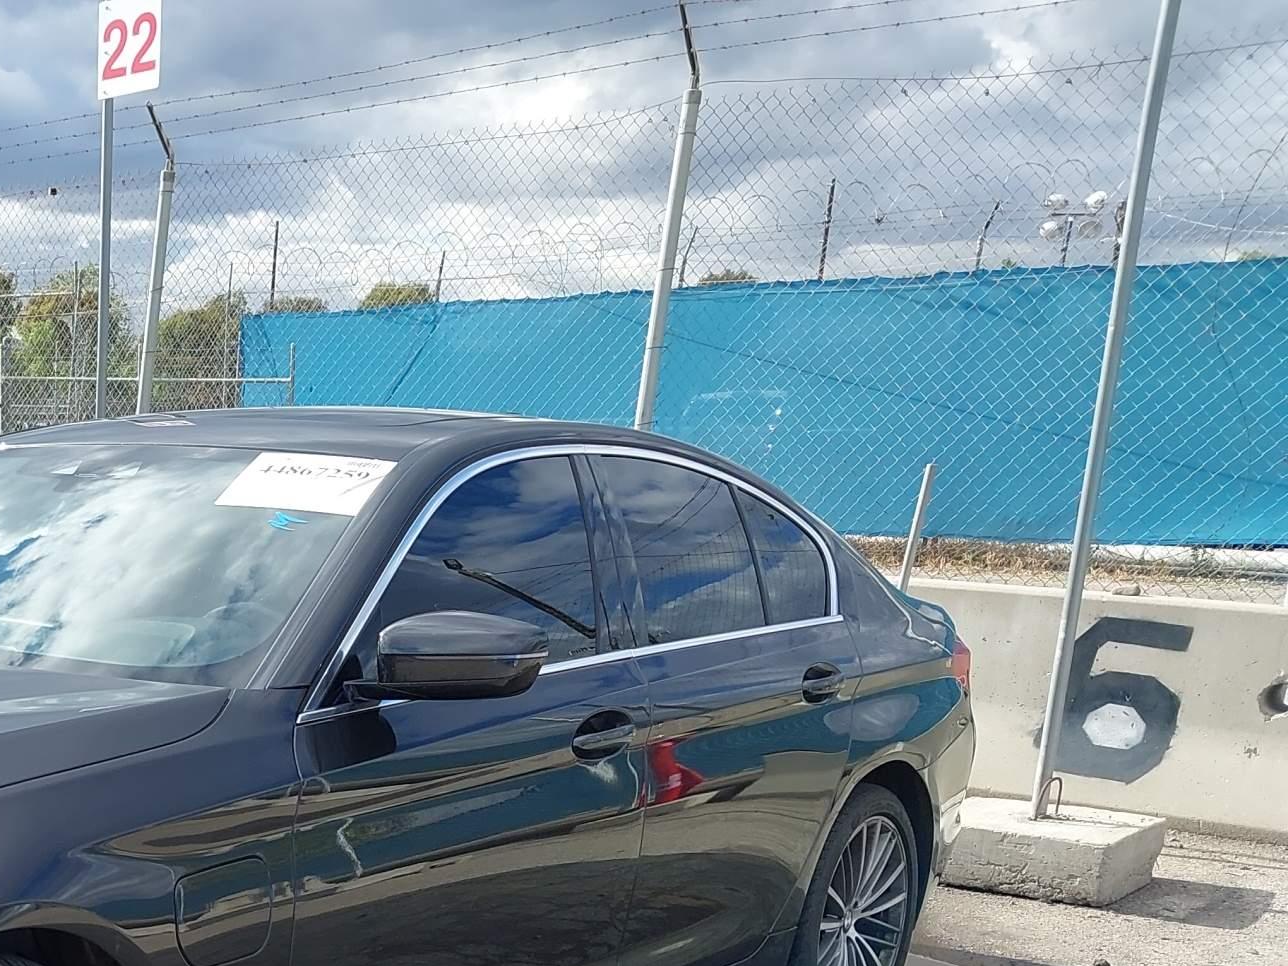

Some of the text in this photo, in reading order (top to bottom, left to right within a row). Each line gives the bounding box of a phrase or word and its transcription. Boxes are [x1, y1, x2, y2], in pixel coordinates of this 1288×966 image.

[102, 12, 157, 80] 22
[260, 464, 371, 480] 44867259
[1033, 616, 1194, 785] 6
